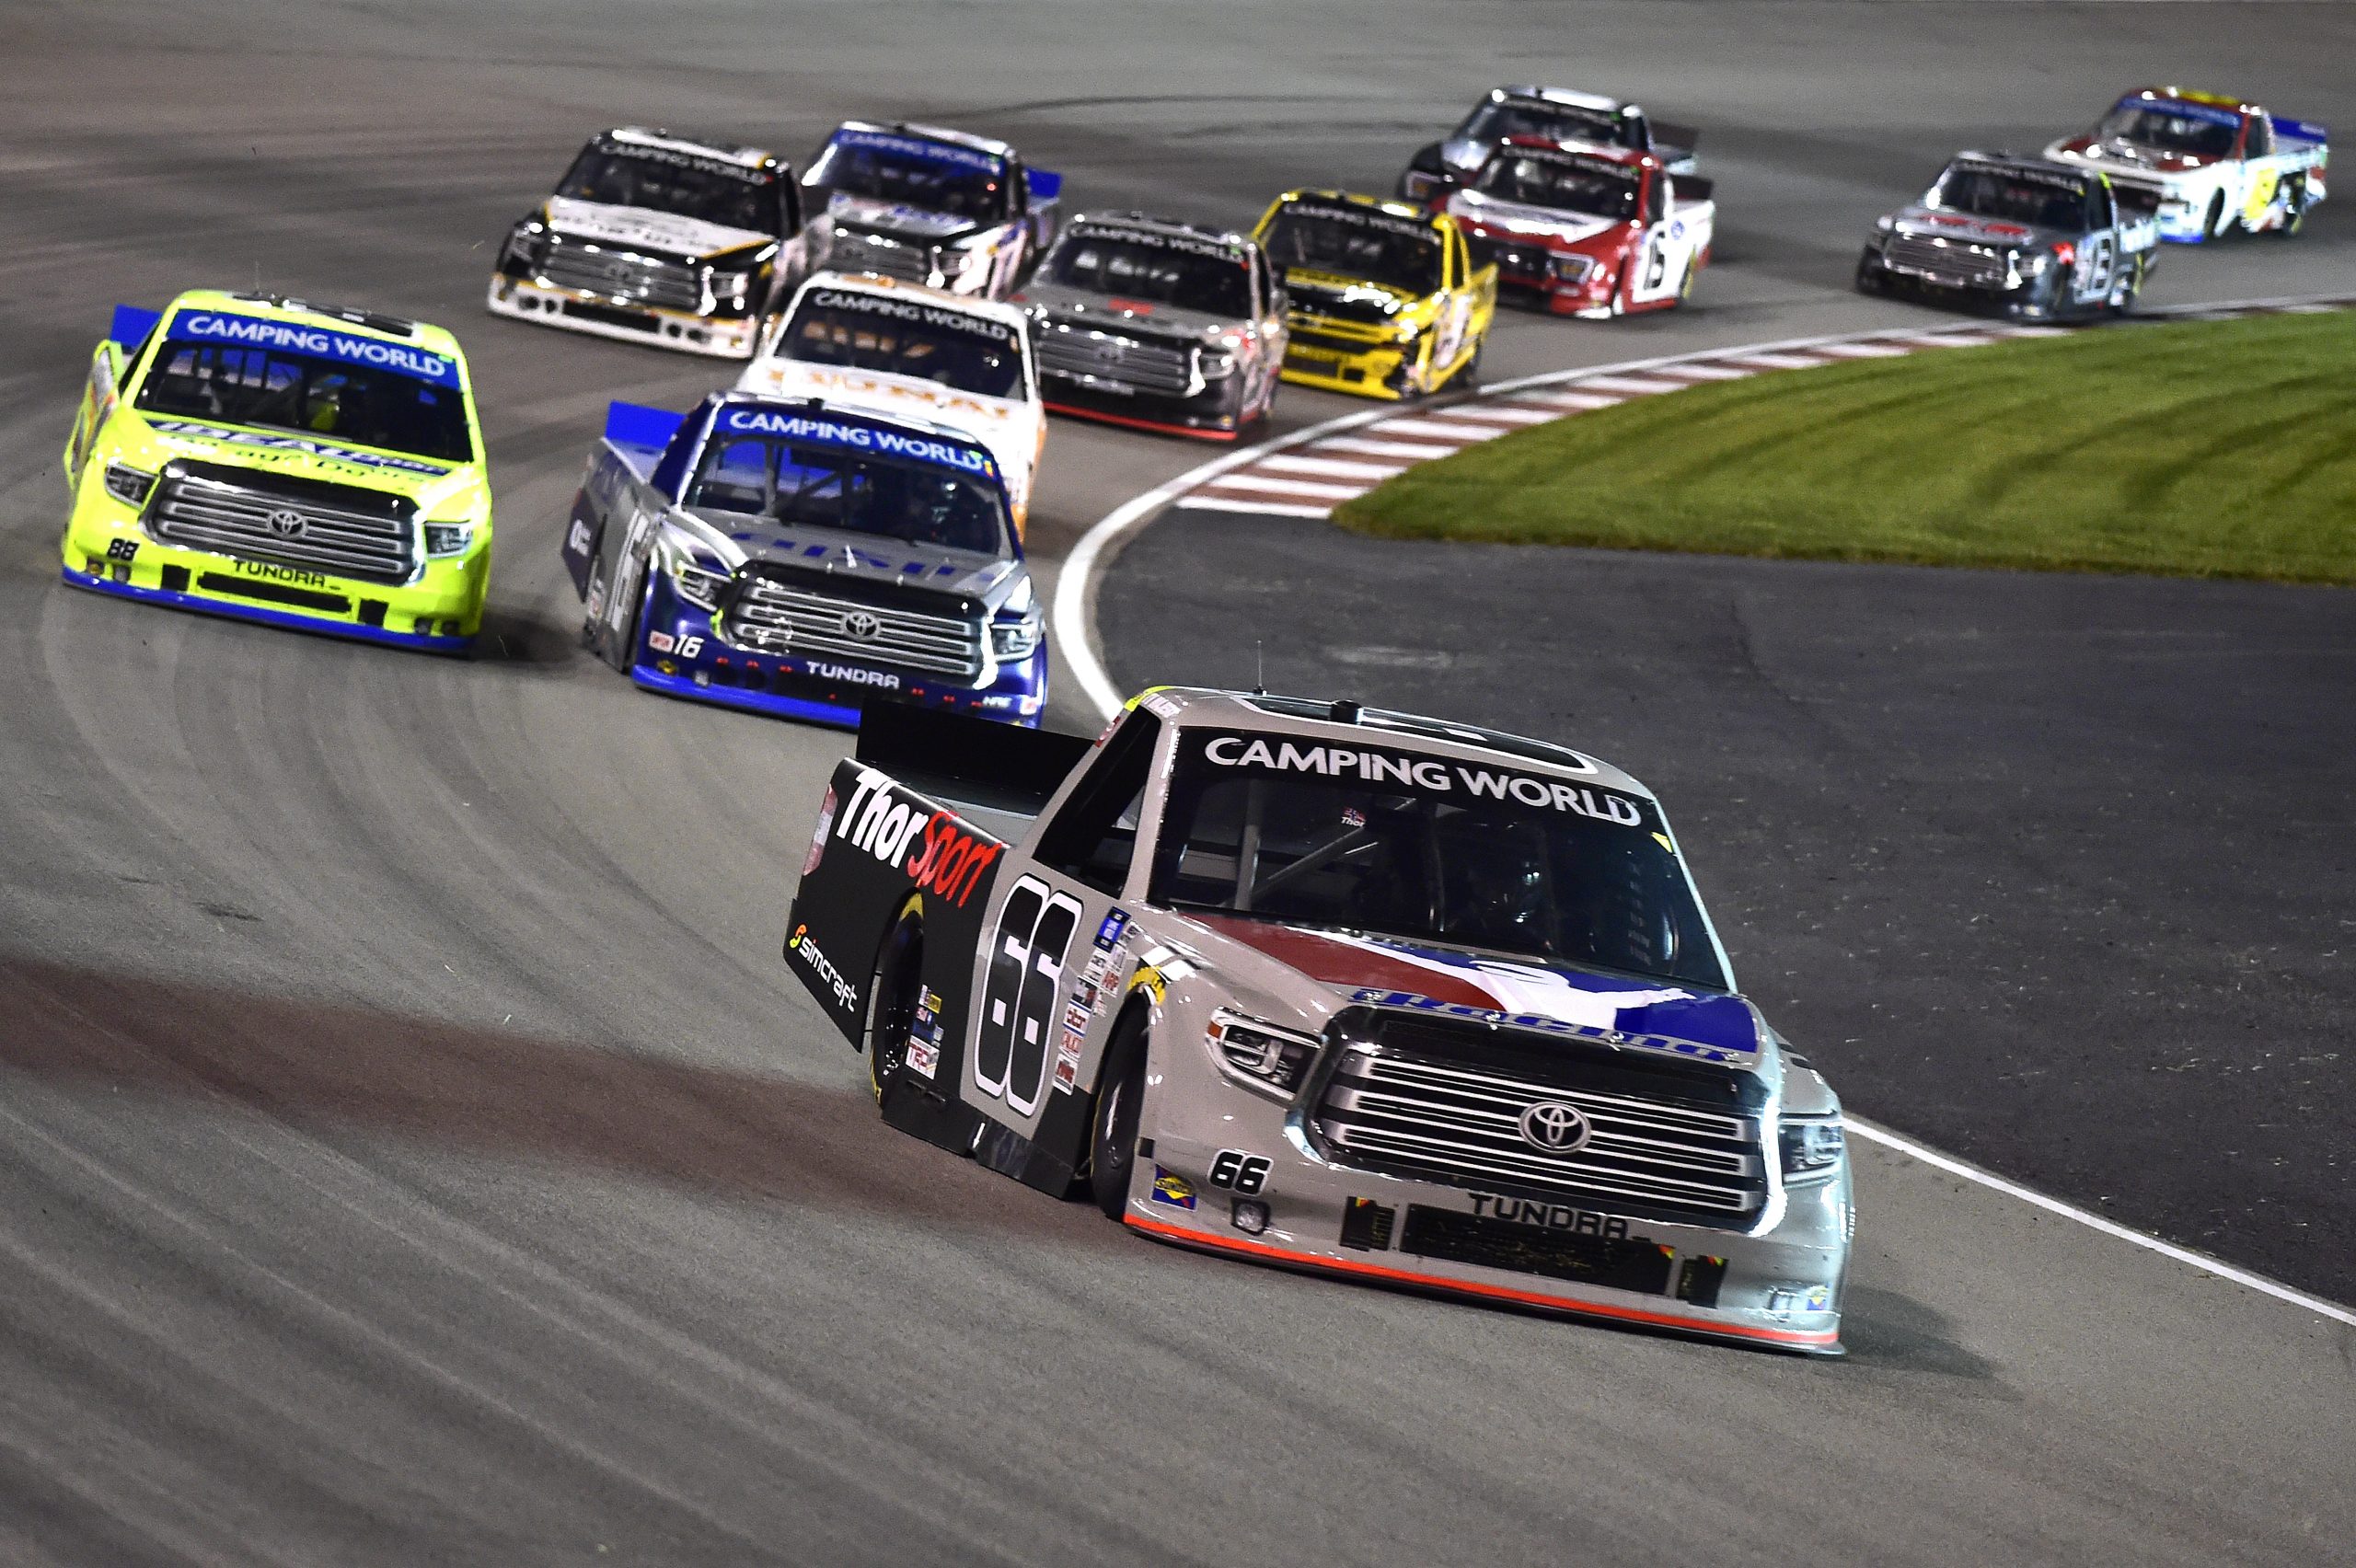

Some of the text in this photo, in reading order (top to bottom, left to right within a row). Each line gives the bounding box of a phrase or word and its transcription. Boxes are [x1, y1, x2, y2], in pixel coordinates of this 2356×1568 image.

[814, 290, 1009, 340] CAMPING WORLD
[188, 317, 445, 378] CAMPING WORLD
[729, 412, 984, 471] CAMPING WORLD
[108, 537, 139, 562] 88
[233, 559, 326, 589] TUNDRA
[673, 633, 704, 660] 16
[806, 660, 900, 690] TUNDRA
[1204, 737, 1642, 827] CAMPING WORLD
[1341, 816, 1366, 827] Thor
[798, 936, 859, 1013] simcraft
[975, 871, 1084, 1118] 66
[1207, 1148, 1275, 1196] 66
[1467, 1192, 1630, 1240] TUNDRA
